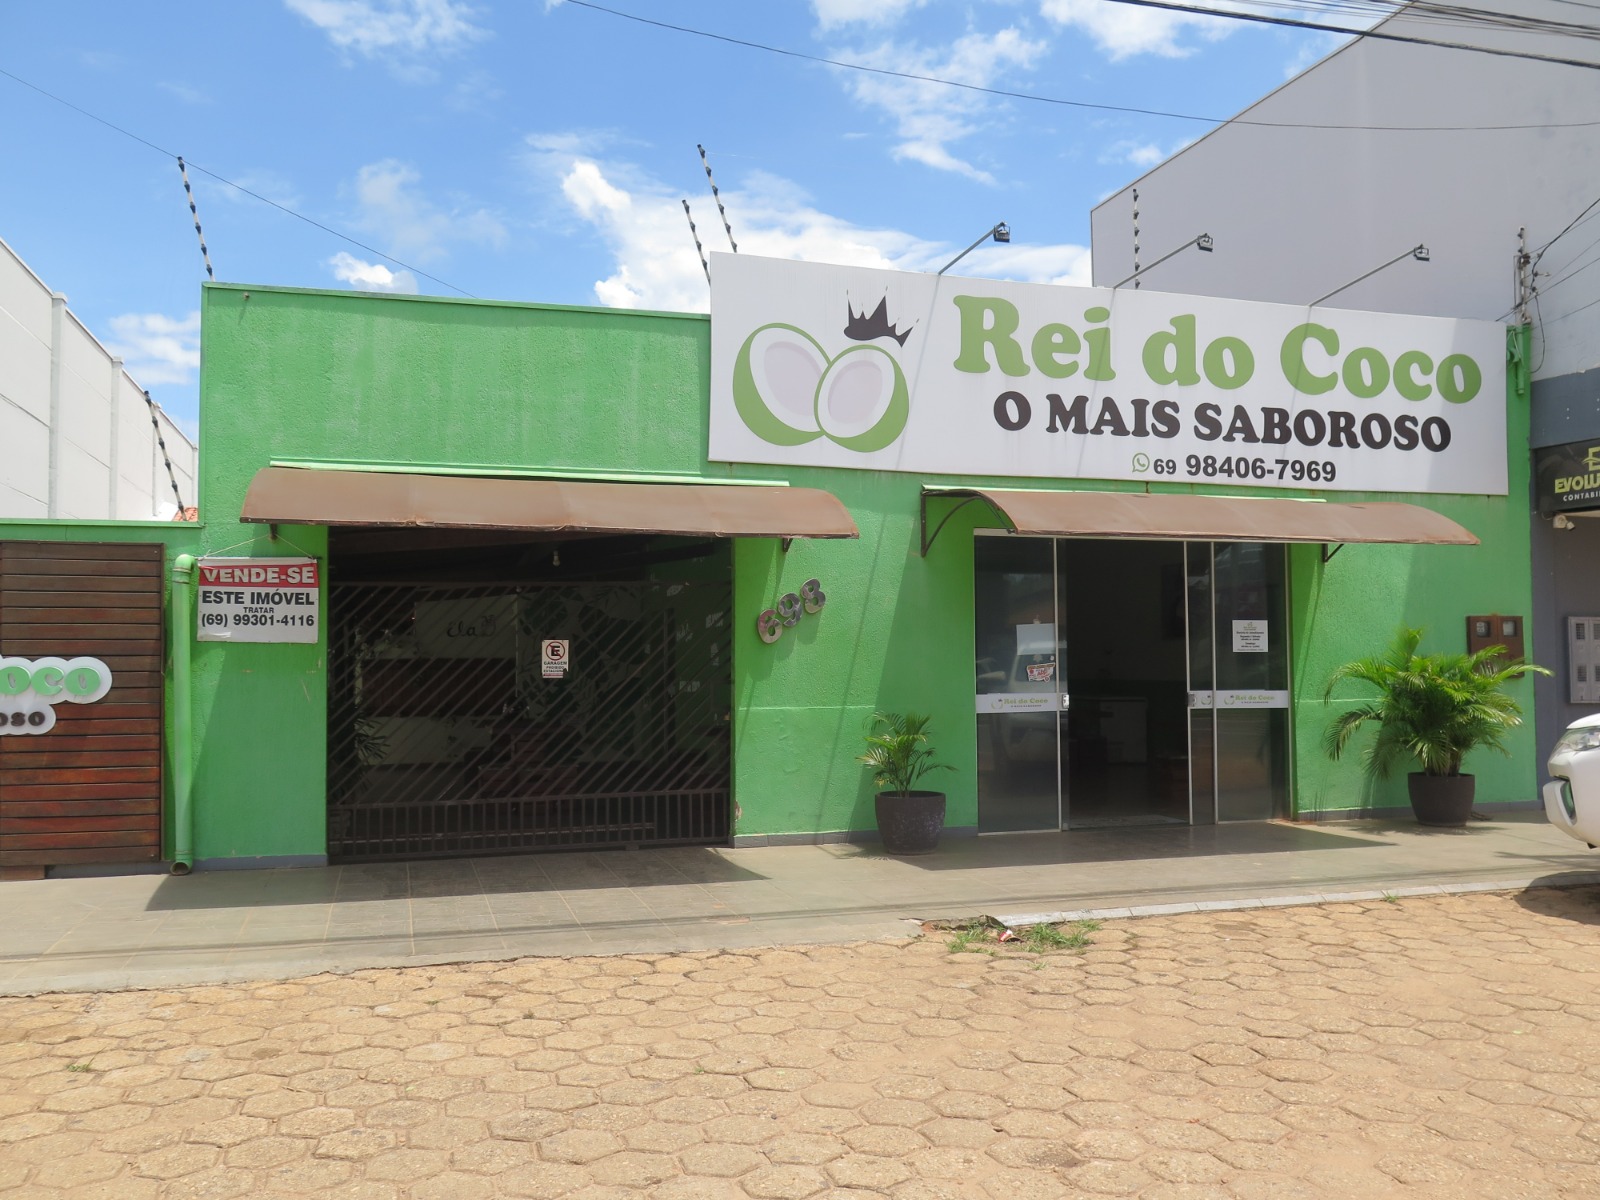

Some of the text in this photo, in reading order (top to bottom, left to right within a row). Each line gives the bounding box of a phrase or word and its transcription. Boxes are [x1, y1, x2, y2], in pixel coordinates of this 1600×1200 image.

[953, 295, 1482, 404] Rei do Coco
[993, 390, 1453, 453] O MAIS SABOROSO
[1154, 454, 1337, 483] 69 98406-7969
[203, 567, 315, 584] VENDE-SE
[202, 588, 315, 606] ESTE IMÓVEL
[201, 613, 315, 628] (69) 99301-4116
[243, 606, 275, 614] TRATAR
[757, 577, 827, 644] 698
